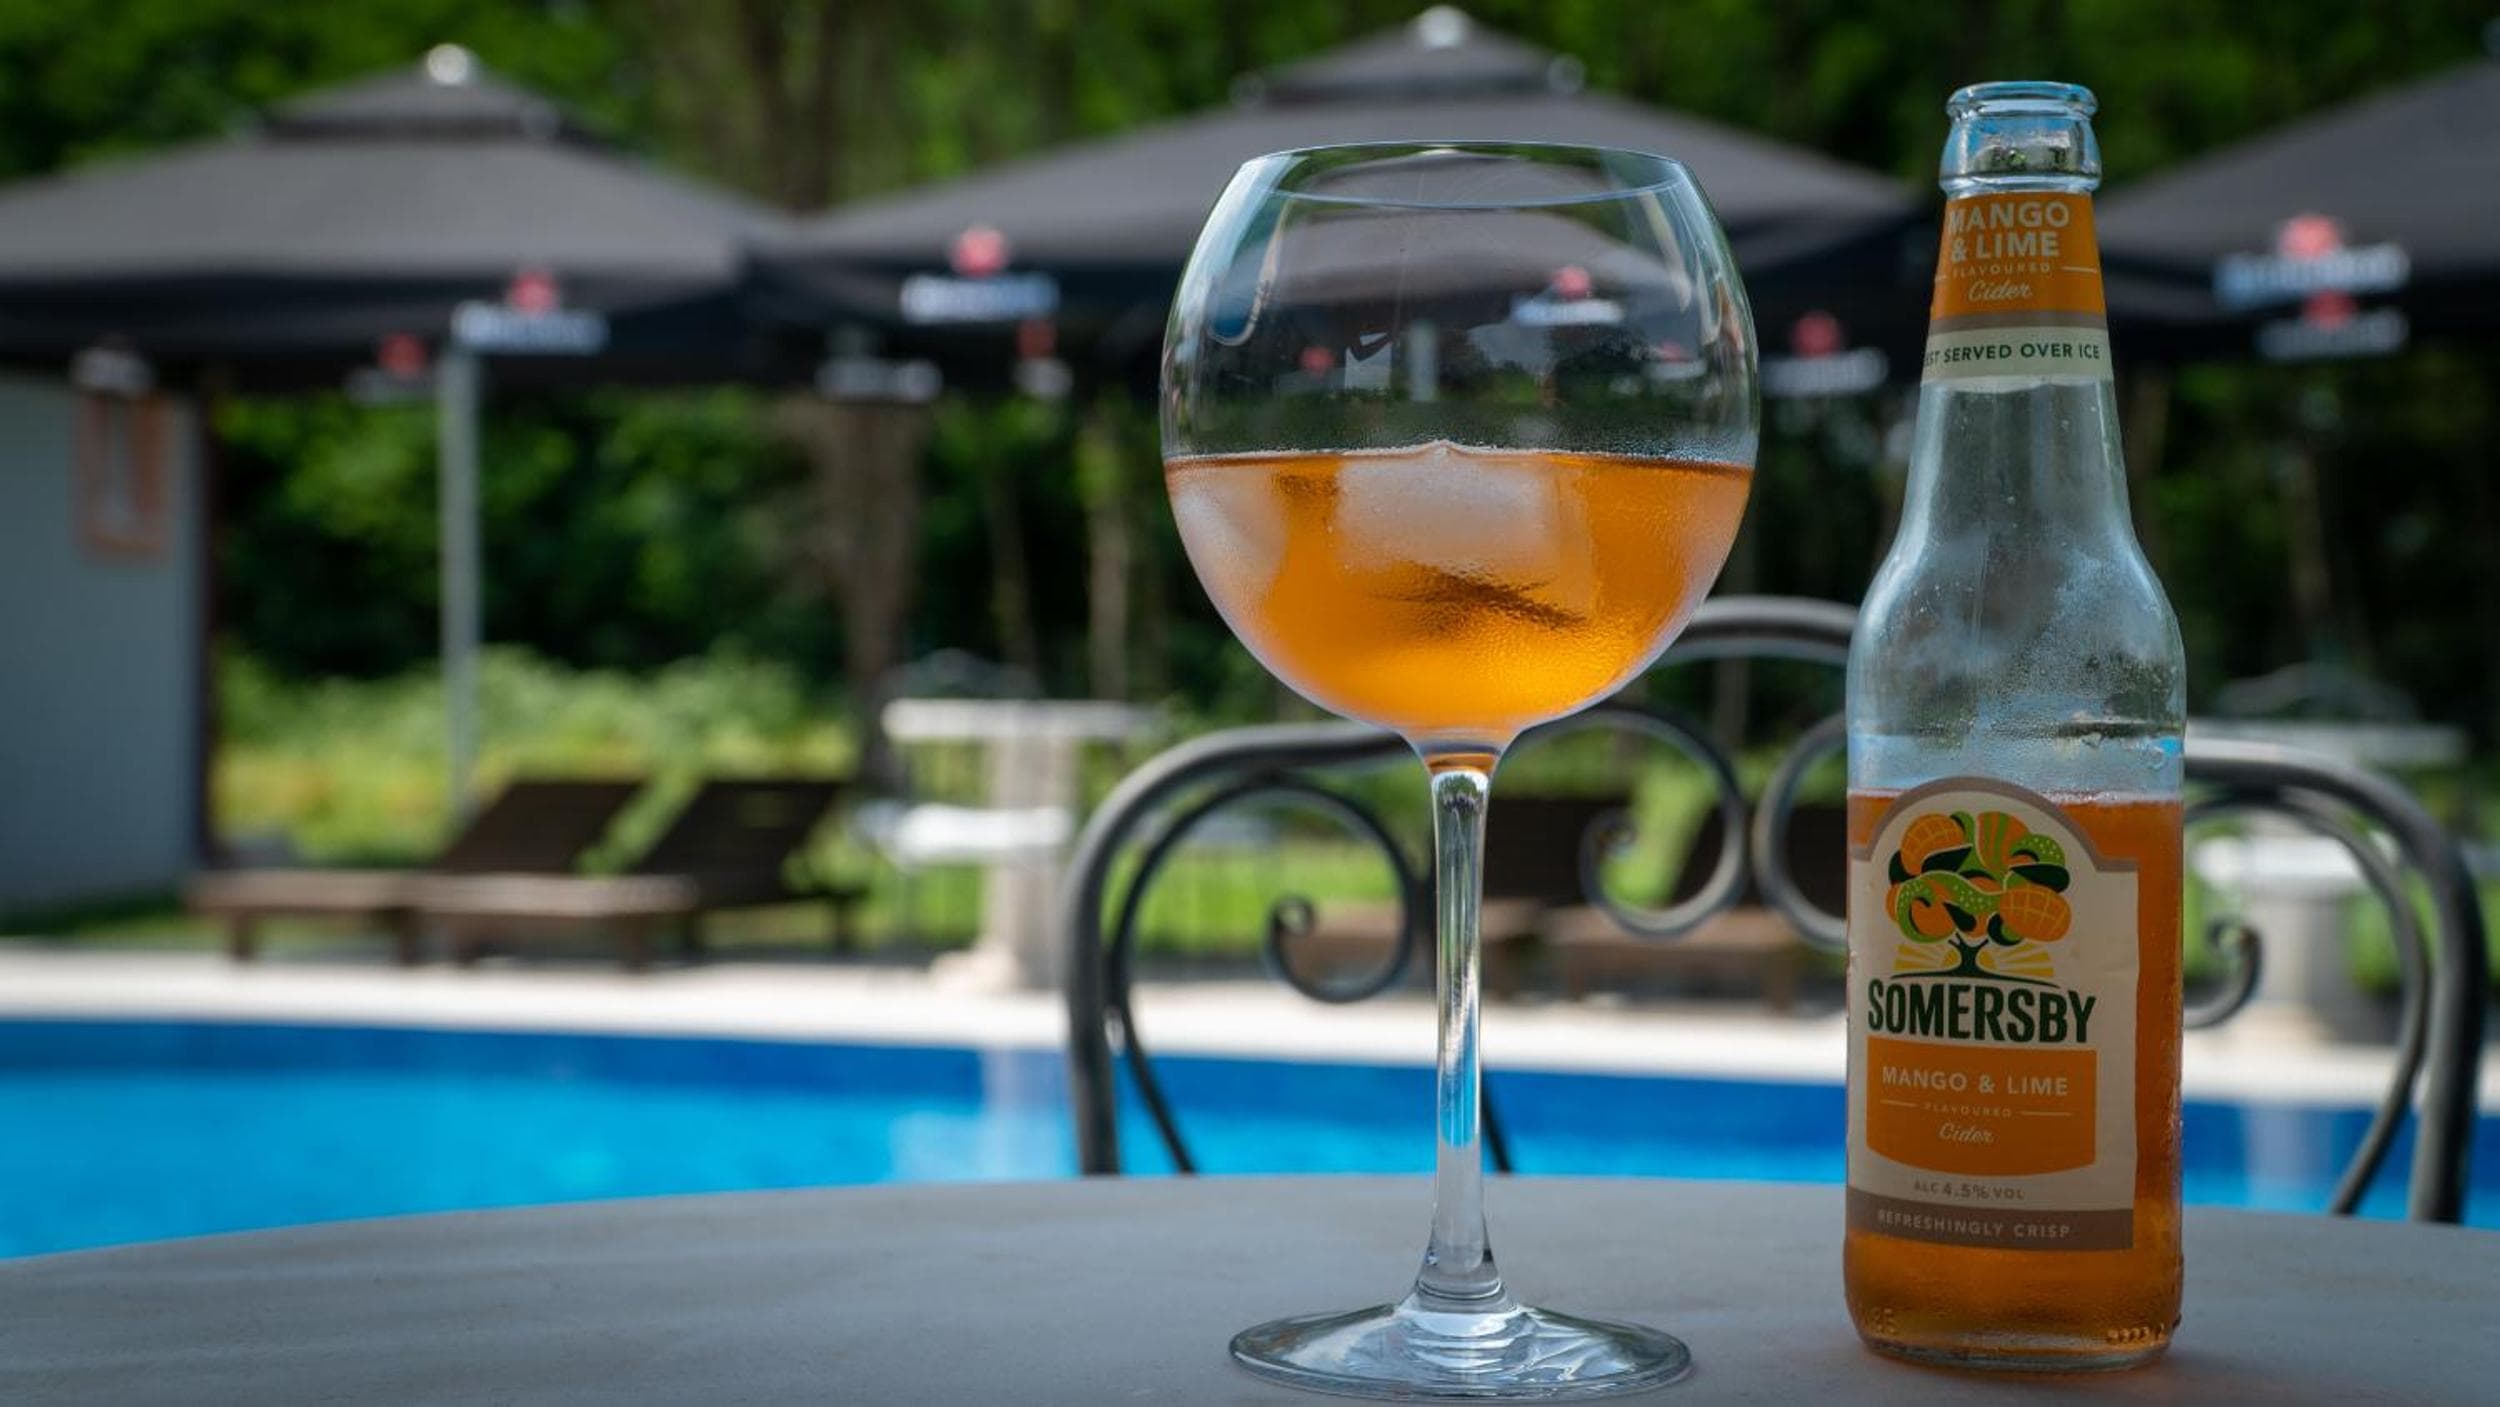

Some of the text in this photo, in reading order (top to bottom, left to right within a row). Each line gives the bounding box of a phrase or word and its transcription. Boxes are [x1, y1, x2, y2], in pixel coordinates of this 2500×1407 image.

[1947, 202, 2070, 235] MANGO
[1951, 231, 2060, 262] & LIME
[1953, 264, 2051, 278] FLAVOURED
[1968, 280, 2033, 301] Cider
[1944, 344, 2012, 363] SERVED
[2020, 343, 2073, 358] OVER
[2079, 344, 2100, 359] ICE
[1867, 979, 2097, 1043] SOMERSBY
[1882, 1066, 2069, 1096] MANGO & LIME
[1924, 1101, 2013, 1118] FLAVOURED
[1939, 1121, 1995, 1143] Cider
[1878, 1209, 2071, 1239] REFRESHINGLY CRISP
